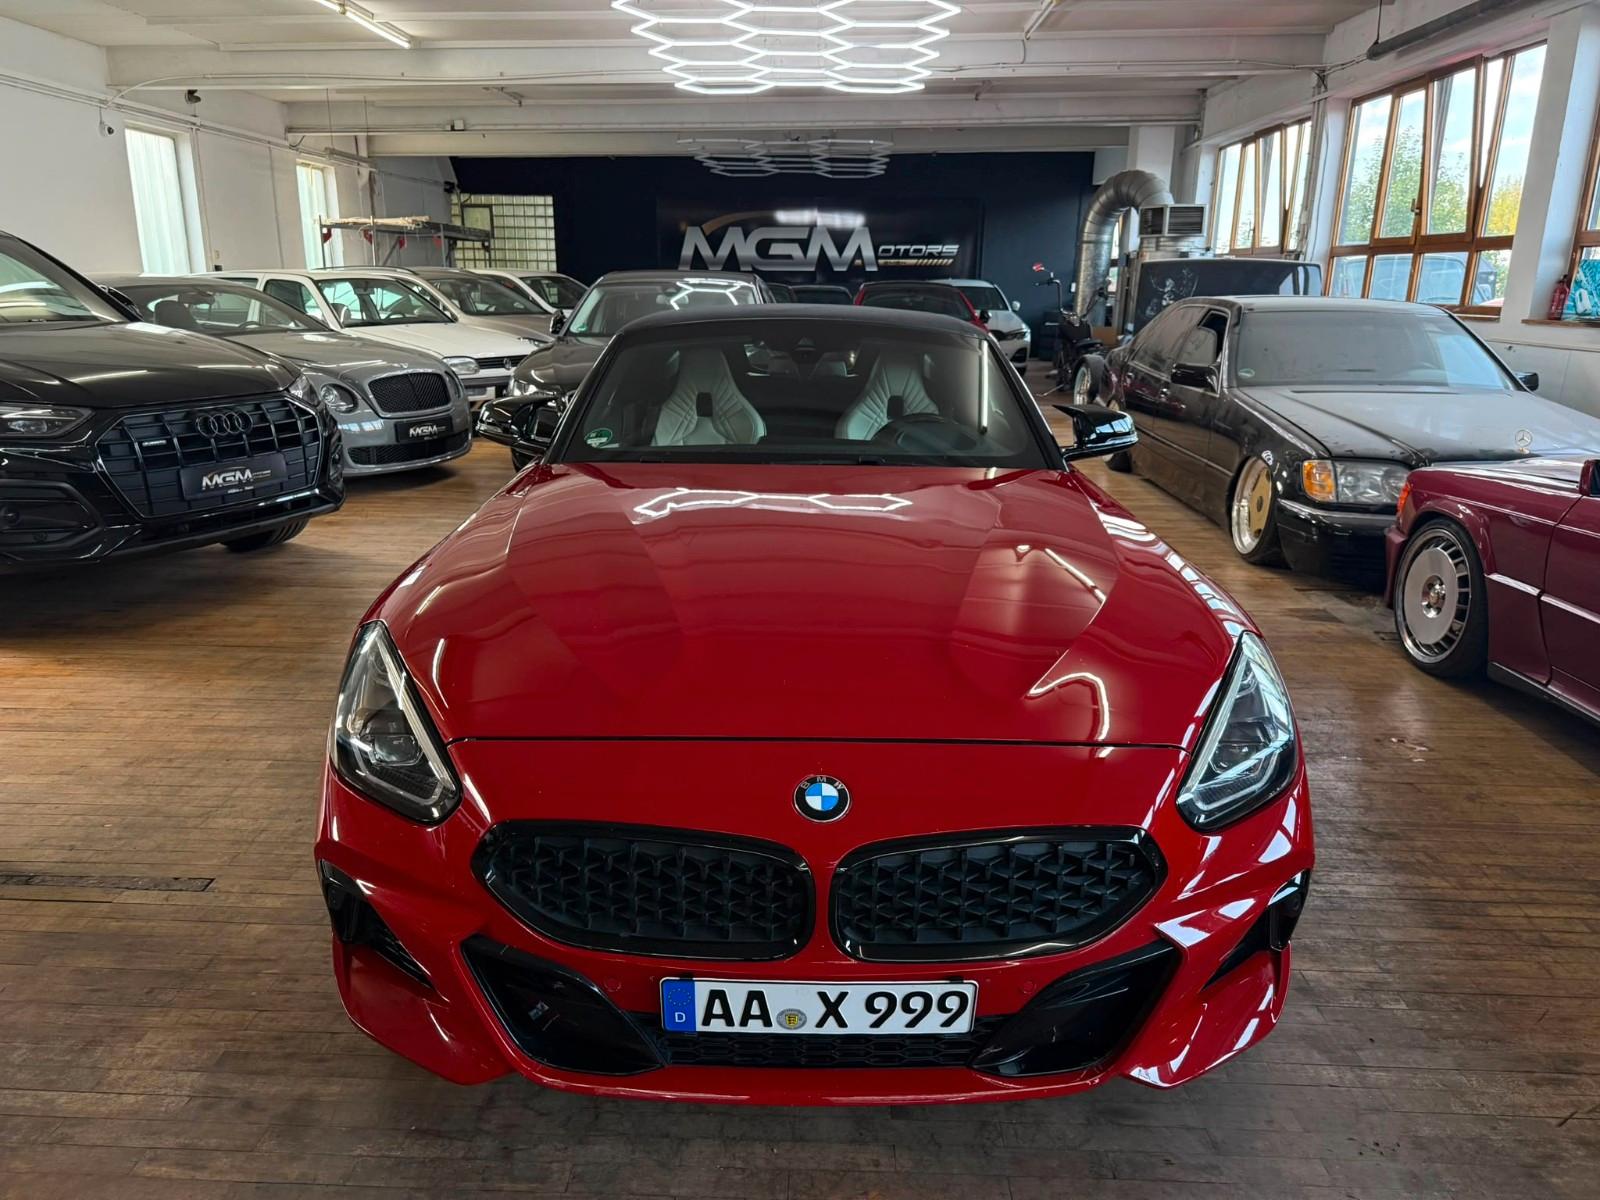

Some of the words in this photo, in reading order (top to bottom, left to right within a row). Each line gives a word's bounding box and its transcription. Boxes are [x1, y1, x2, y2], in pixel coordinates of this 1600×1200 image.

[202, 469, 254, 490] MGM
[674, 1012, 687, 1024] D
[701, 989, 773, 1028] AA
[815, 991, 849, 1029] X
[864, 991, 970, 1029] 999
